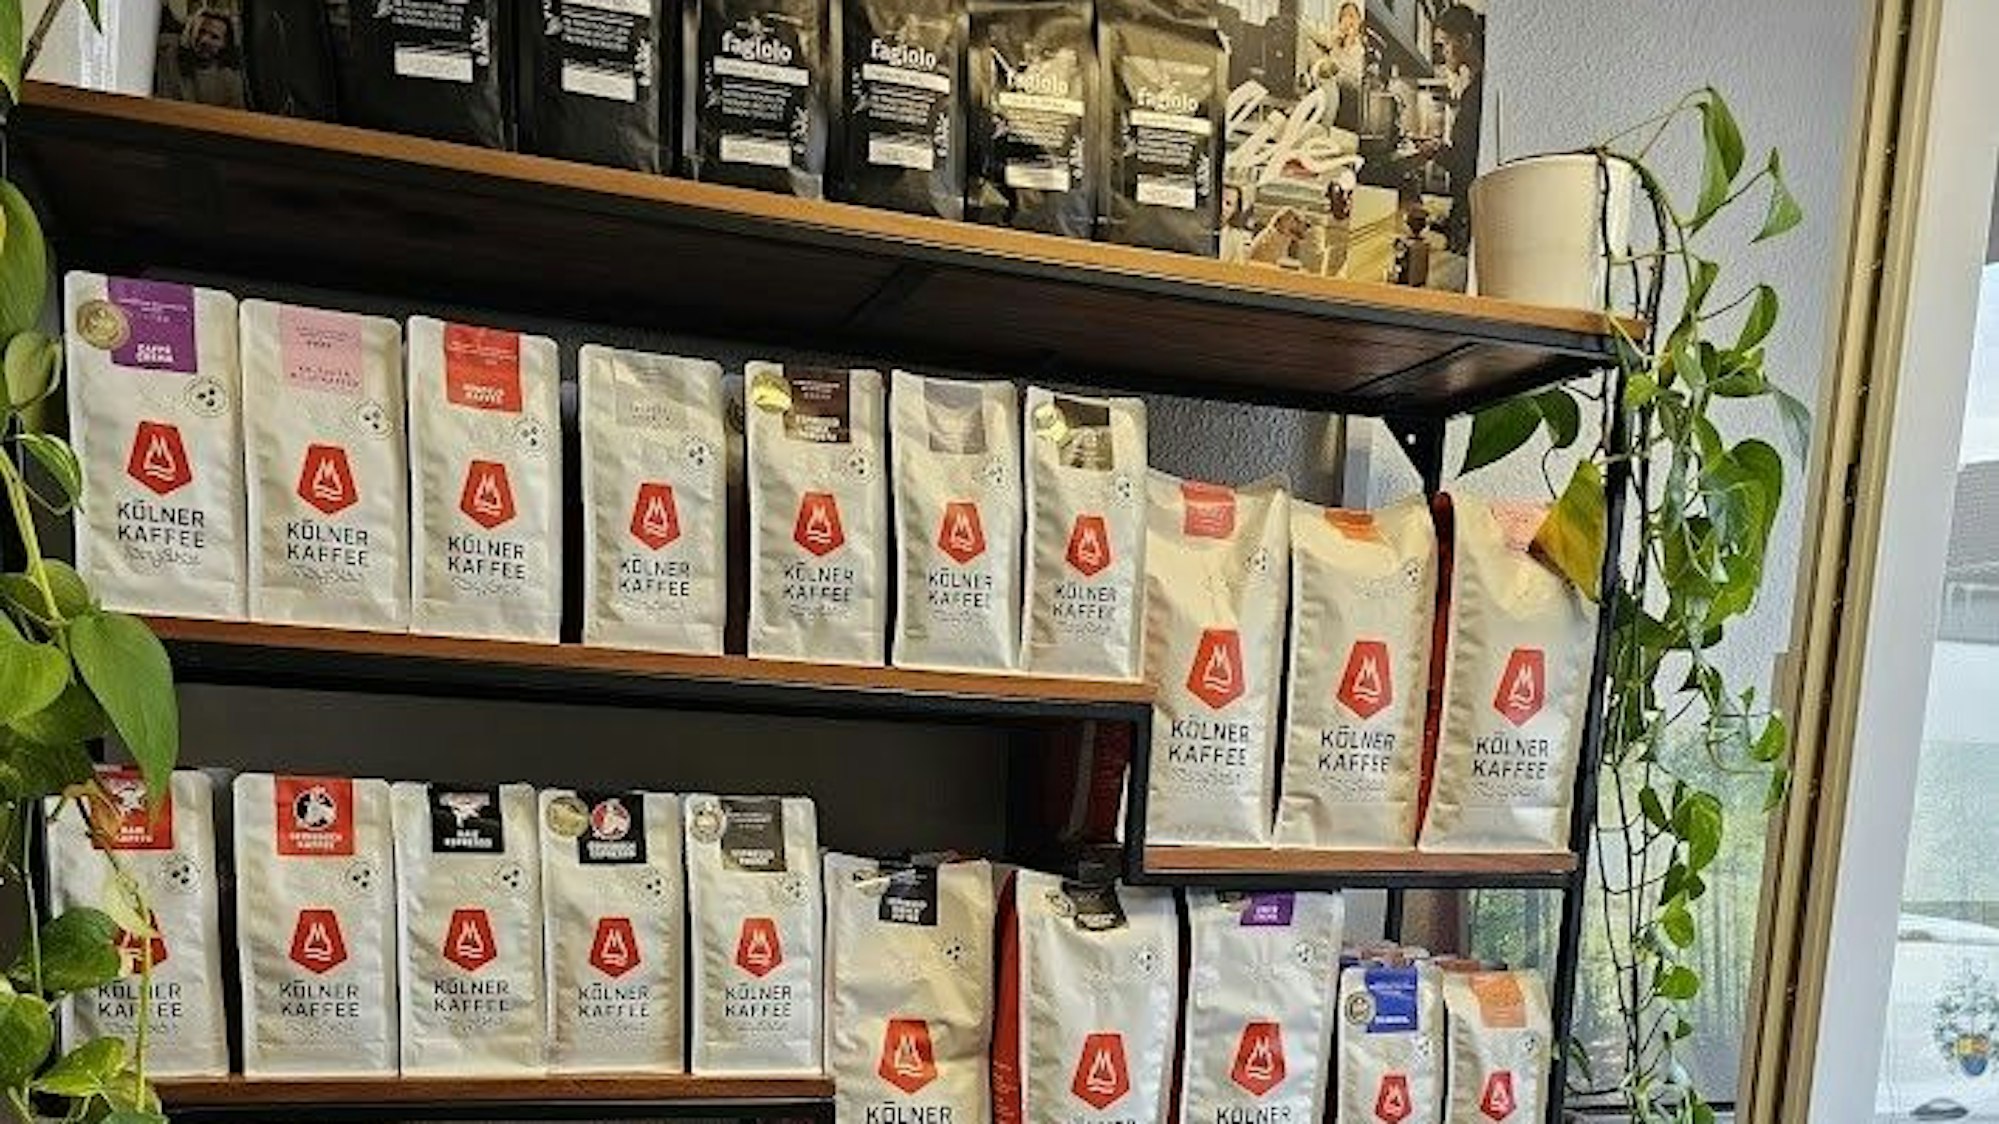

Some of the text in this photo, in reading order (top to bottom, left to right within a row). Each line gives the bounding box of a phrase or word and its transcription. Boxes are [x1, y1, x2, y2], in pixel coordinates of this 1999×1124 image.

[721, 30, 793, 63] fagiolo
[871, 38, 937, 69] fagiolo
[1136, 87, 1199, 112] fagiolo
[117, 500, 205, 529] KÖLNER
[118, 524, 205, 548] KAFFEE
[287, 520, 369, 546] KÖLNER
[287, 545, 369, 567] KAFFEE
[448, 535, 524, 560] KÖLNER
[448, 556, 525, 580] KAFFEE
[620, 554, 690, 579] KÖLNER
[619, 579, 690, 597] KAFFEE
[782, 584, 853, 602] KAFFEE
[928, 590, 990, 609] KAFFEE
[1052, 602, 1115, 621] KAFFEE
[1170, 714, 1249, 743] KÖLNER
[1321, 725, 1396, 751] KÖLNER
[1475, 731, 1549, 758] KÖLNER
[1168, 746, 1246, 766] KAFFEE
[1318, 753, 1391, 773] KAFFEE
[1472, 759, 1548, 780] KAFFEE
[98, 980, 182, 1000] KÖLER
[279, 980, 360, 999] KÖLNER
[434, 979, 510, 995] KÖLNER
[578, 983, 651, 1000] KÖLNER
[725, 984, 792, 1000] KÖLNER
[98, 1002, 183, 1017] KAFEE
[281, 1002, 360, 1018] KAFFEE
[434, 999, 510, 1013] KAFFEE
[578, 1003, 650, 1018] KAFFEE
[724, 1003, 792, 1018] KAFFEE
[866, 1101, 952, 1124] KÖLNER
[1217, 1104, 1291, 1124] KÖLNER
